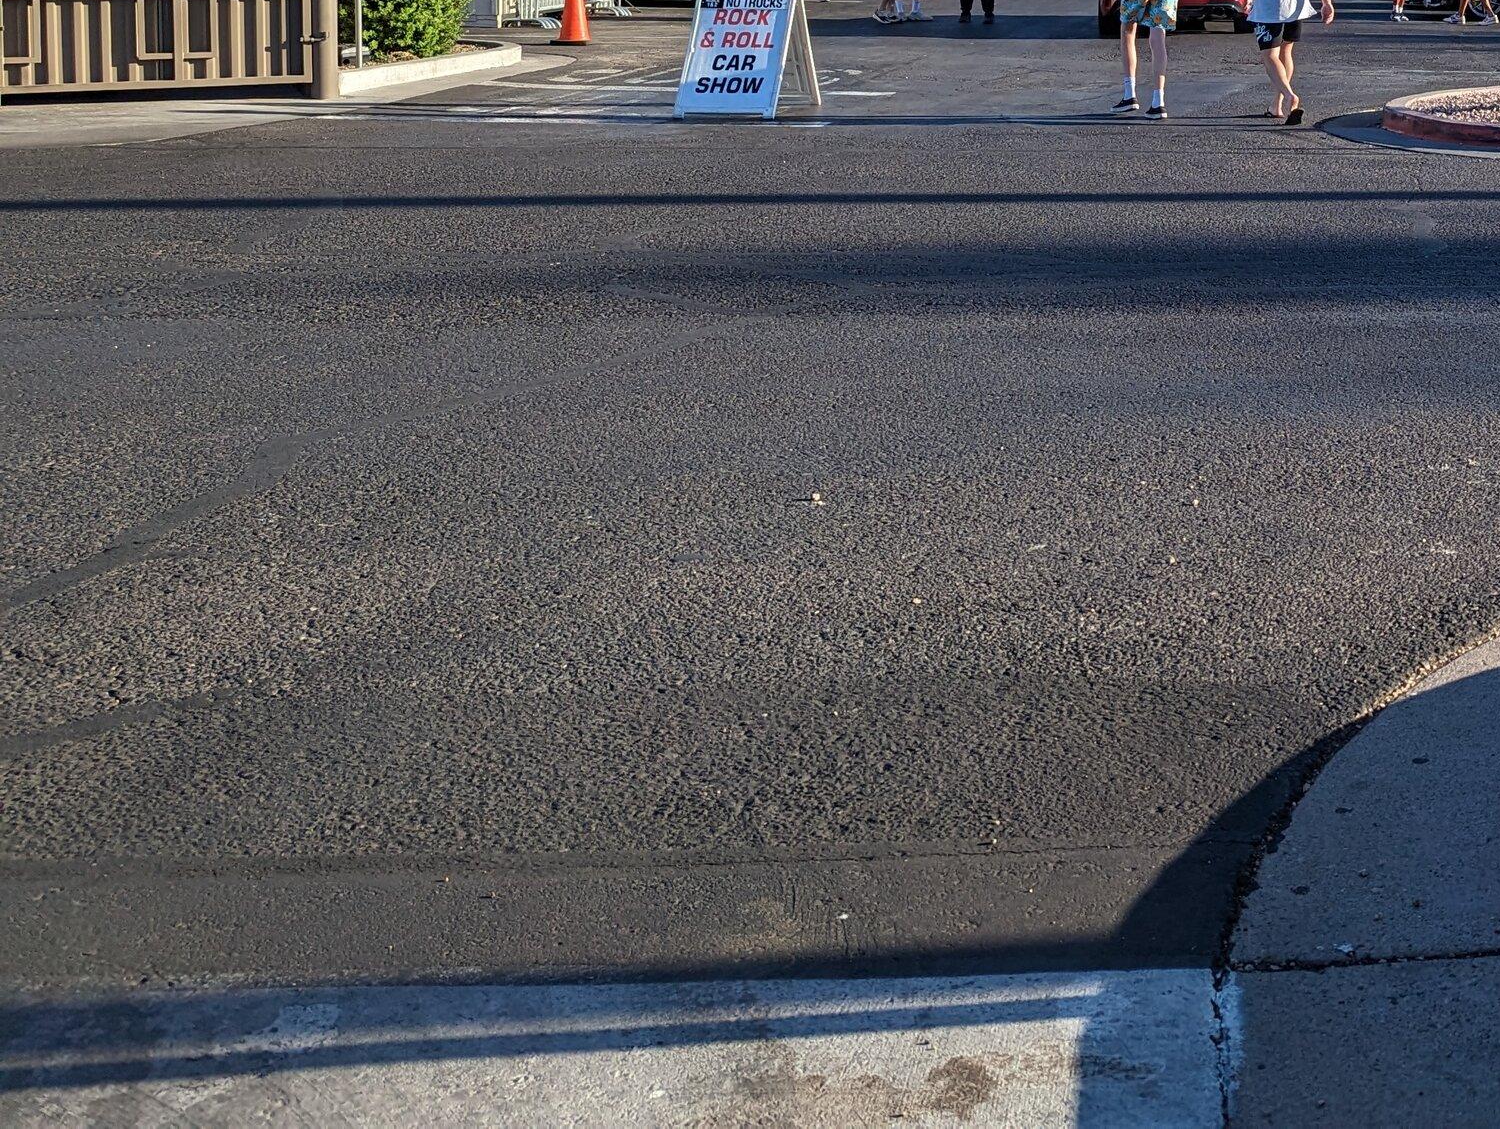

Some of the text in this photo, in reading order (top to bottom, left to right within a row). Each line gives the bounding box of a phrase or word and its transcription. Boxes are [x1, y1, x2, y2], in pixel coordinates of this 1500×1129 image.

[713, 9, 772, 26] ROCK
[700, 31, 774, 48] & ROLL
[712, 54, 757, 71] CAR
[695, 76, 765, 94] SHOW
